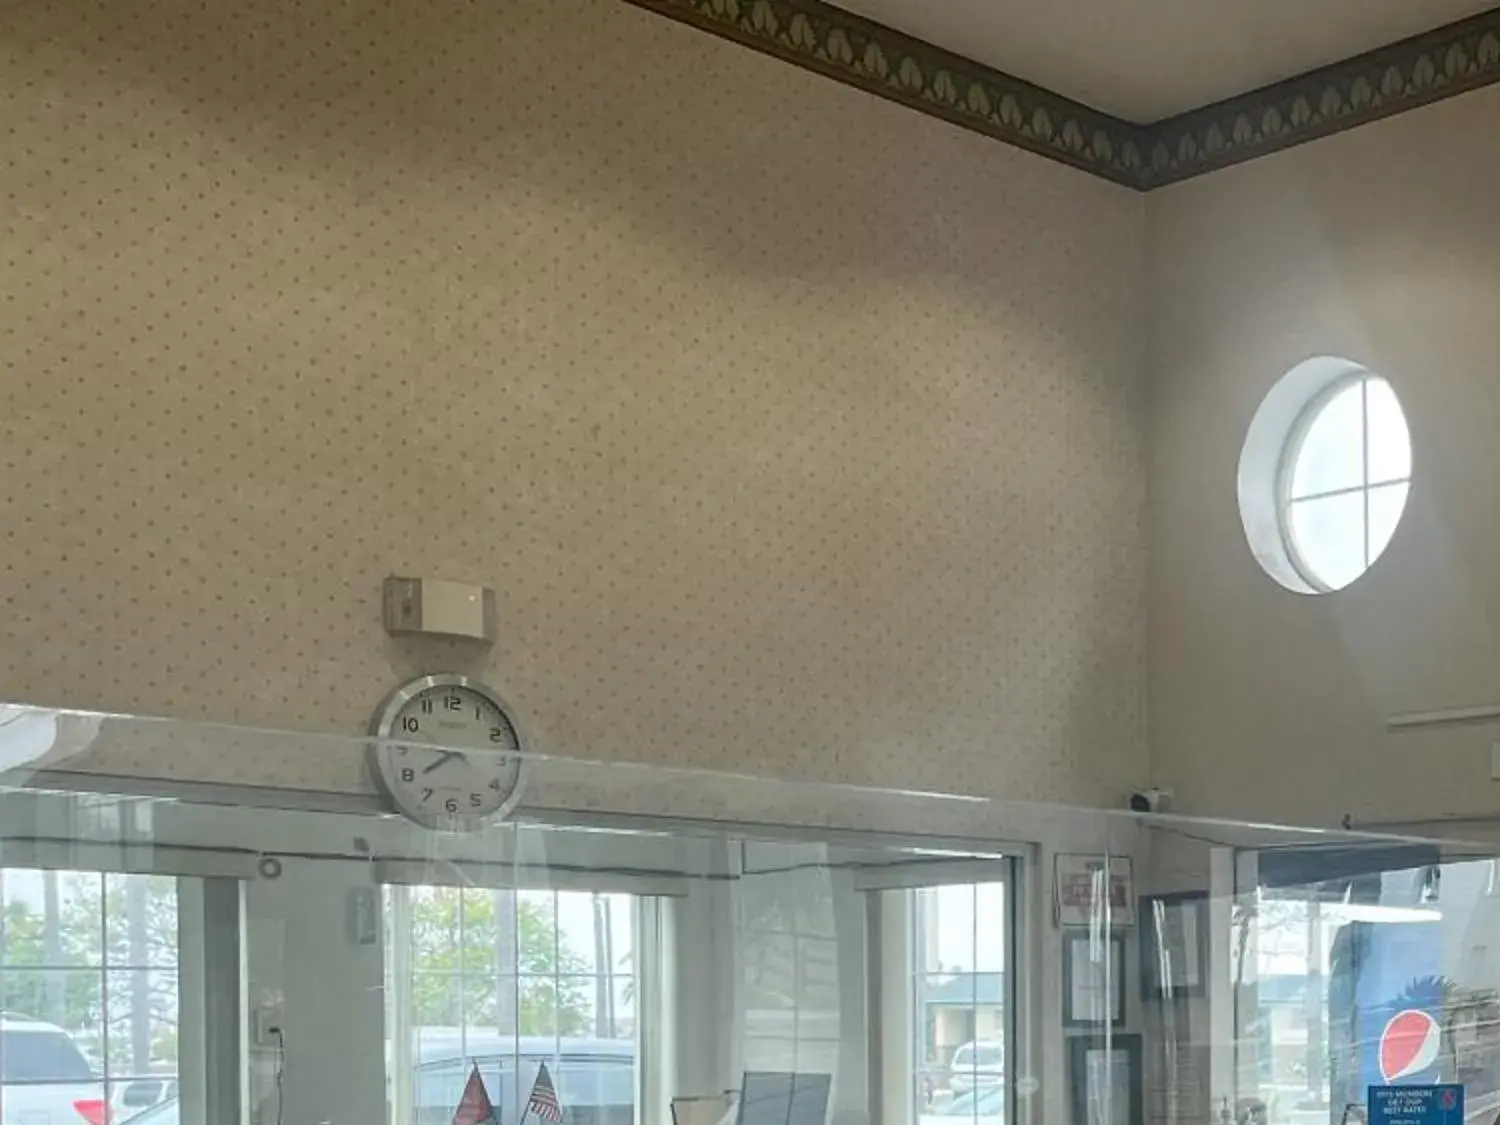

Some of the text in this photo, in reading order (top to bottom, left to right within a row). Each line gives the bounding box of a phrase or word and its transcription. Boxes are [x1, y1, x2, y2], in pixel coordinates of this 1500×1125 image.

[421, 699, 433, 714] 11
[445, 696, 462, 711] 12
[402, 716, 419, 733] 10
[489, 727, 502, 743] 2
[402, 768, 415, 782] 8
[488, 778, 500, 791] 4
[422, 788, 434, 802] 7
[470, 793, 481, 807] 5
[445, 799, 458, 813] 6
